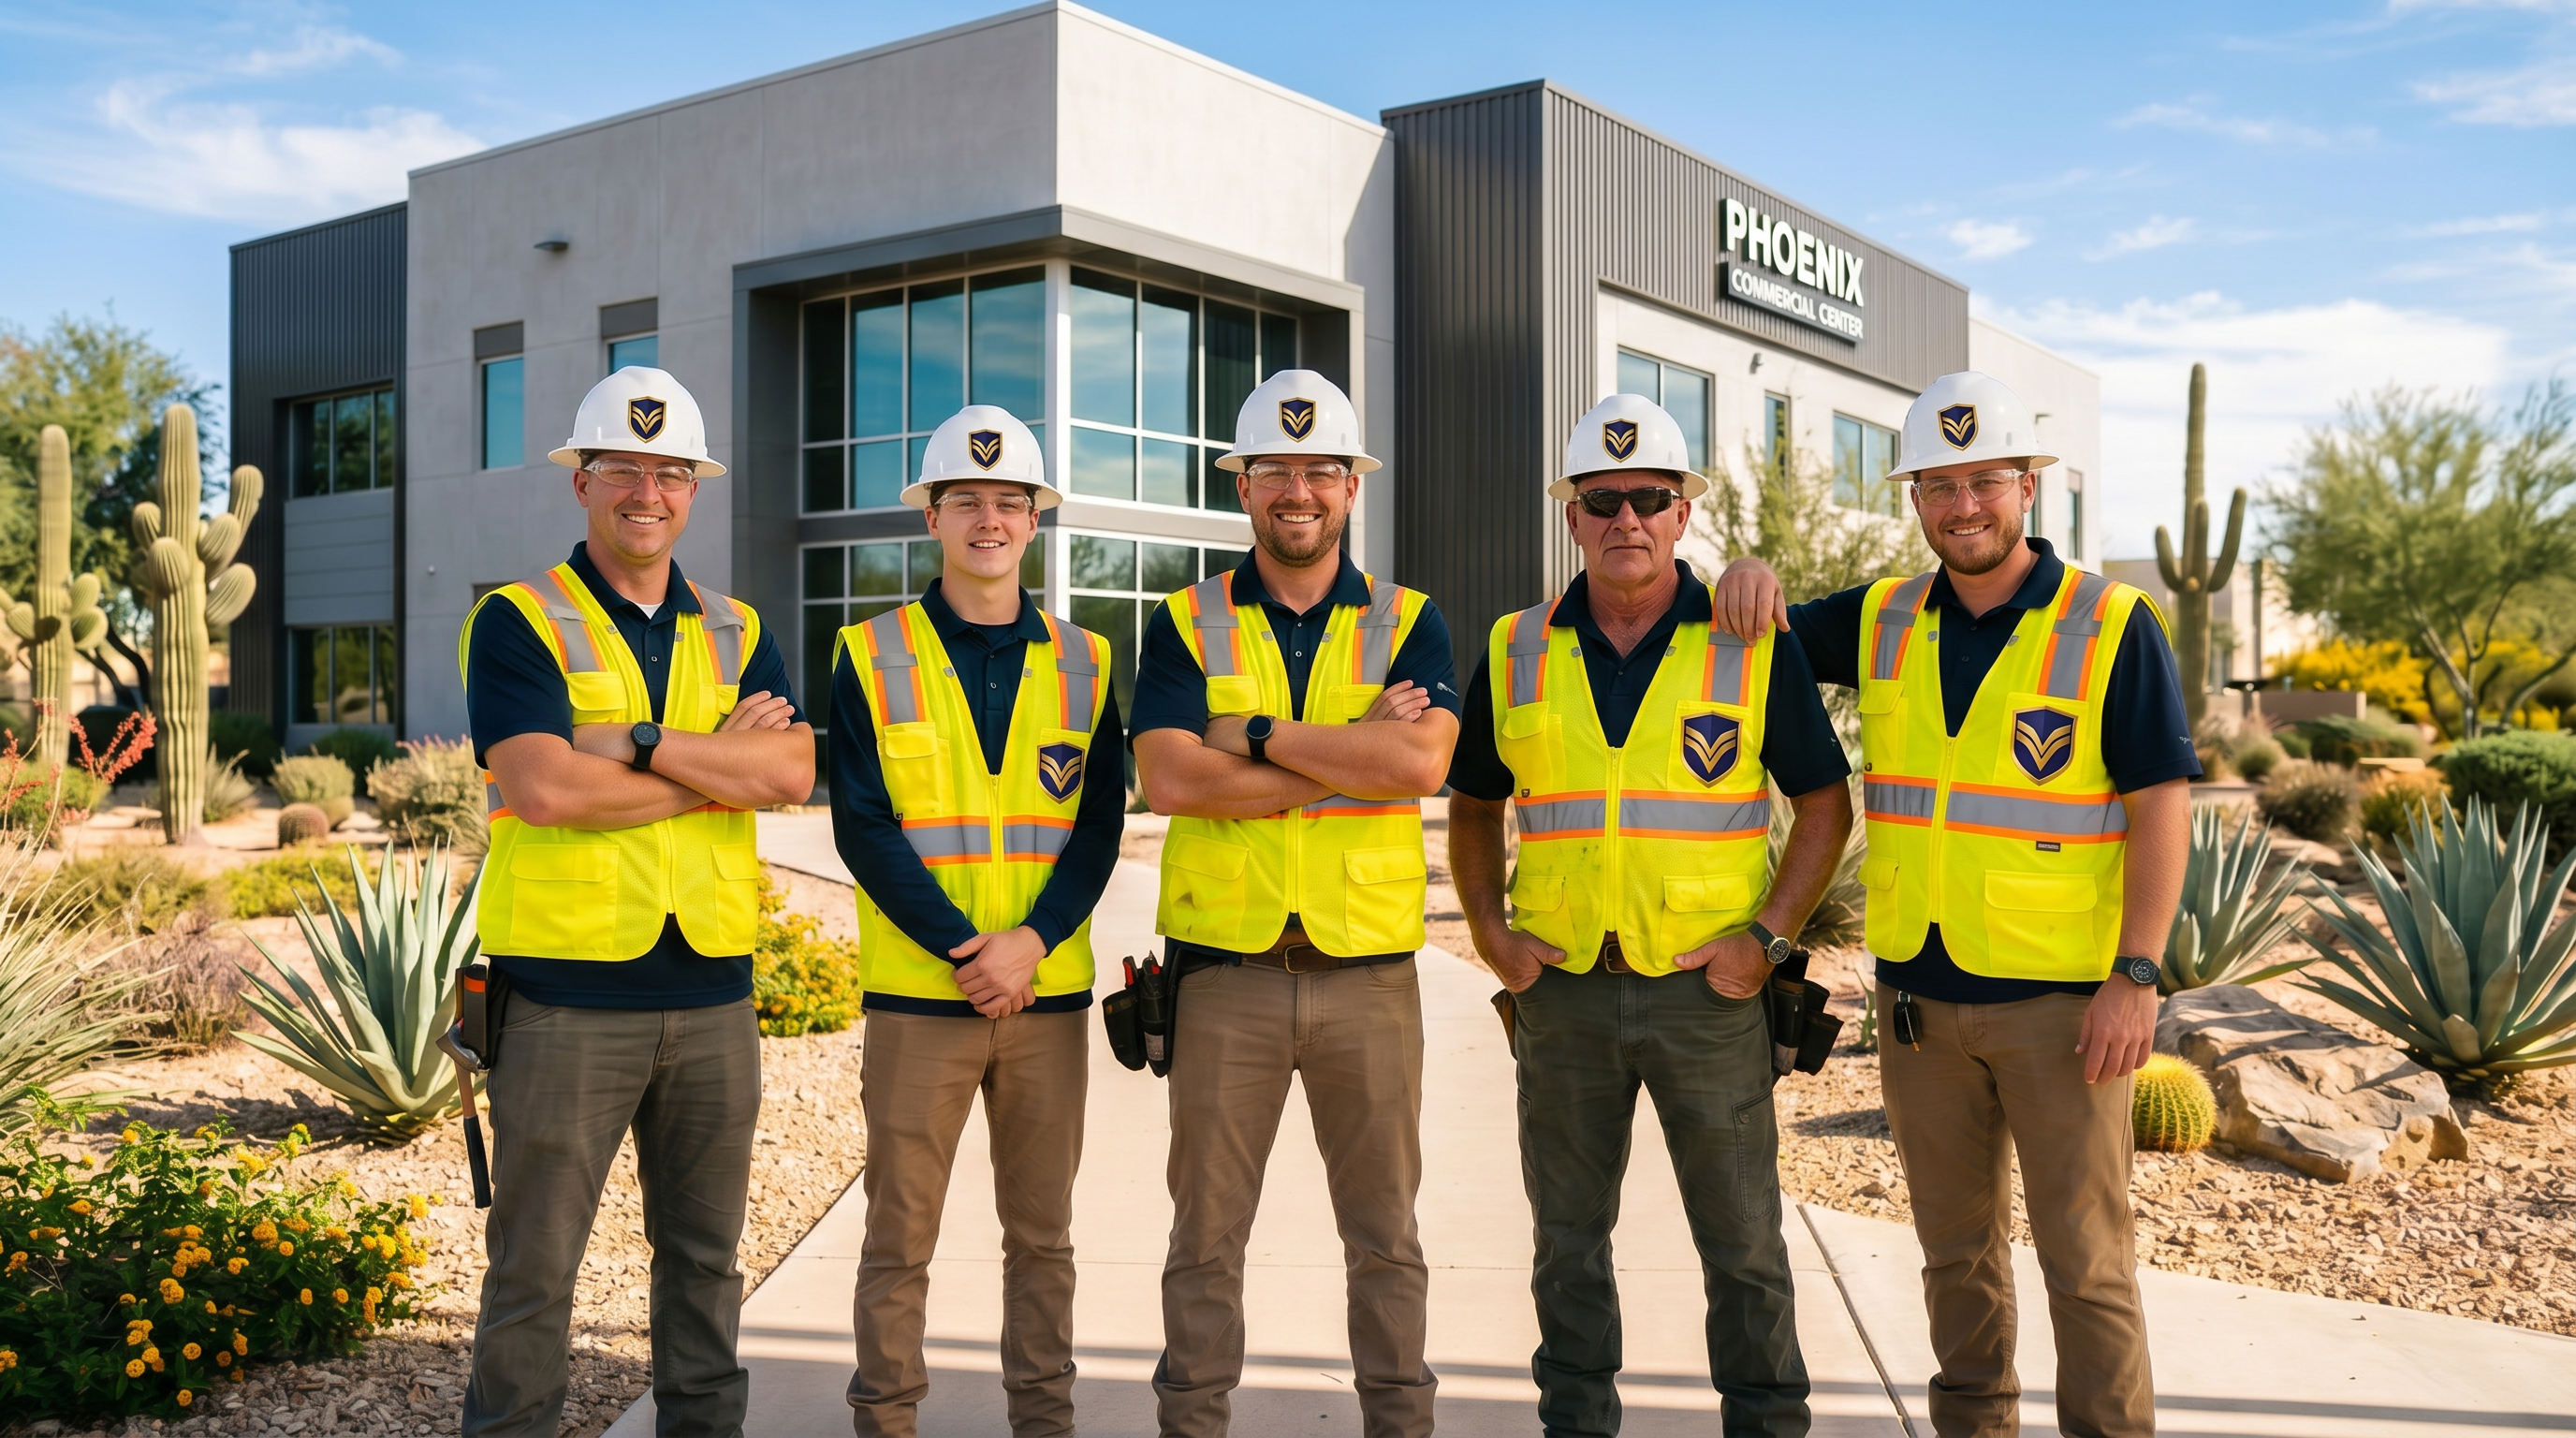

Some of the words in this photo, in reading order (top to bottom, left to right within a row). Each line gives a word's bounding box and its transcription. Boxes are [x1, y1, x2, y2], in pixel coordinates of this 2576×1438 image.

[1725, 198, 1864, 307] PHOENIX
[1732, 268, 1816, 321] COMMERCIAL
[1819, 302, 1864, 339] CENTER
